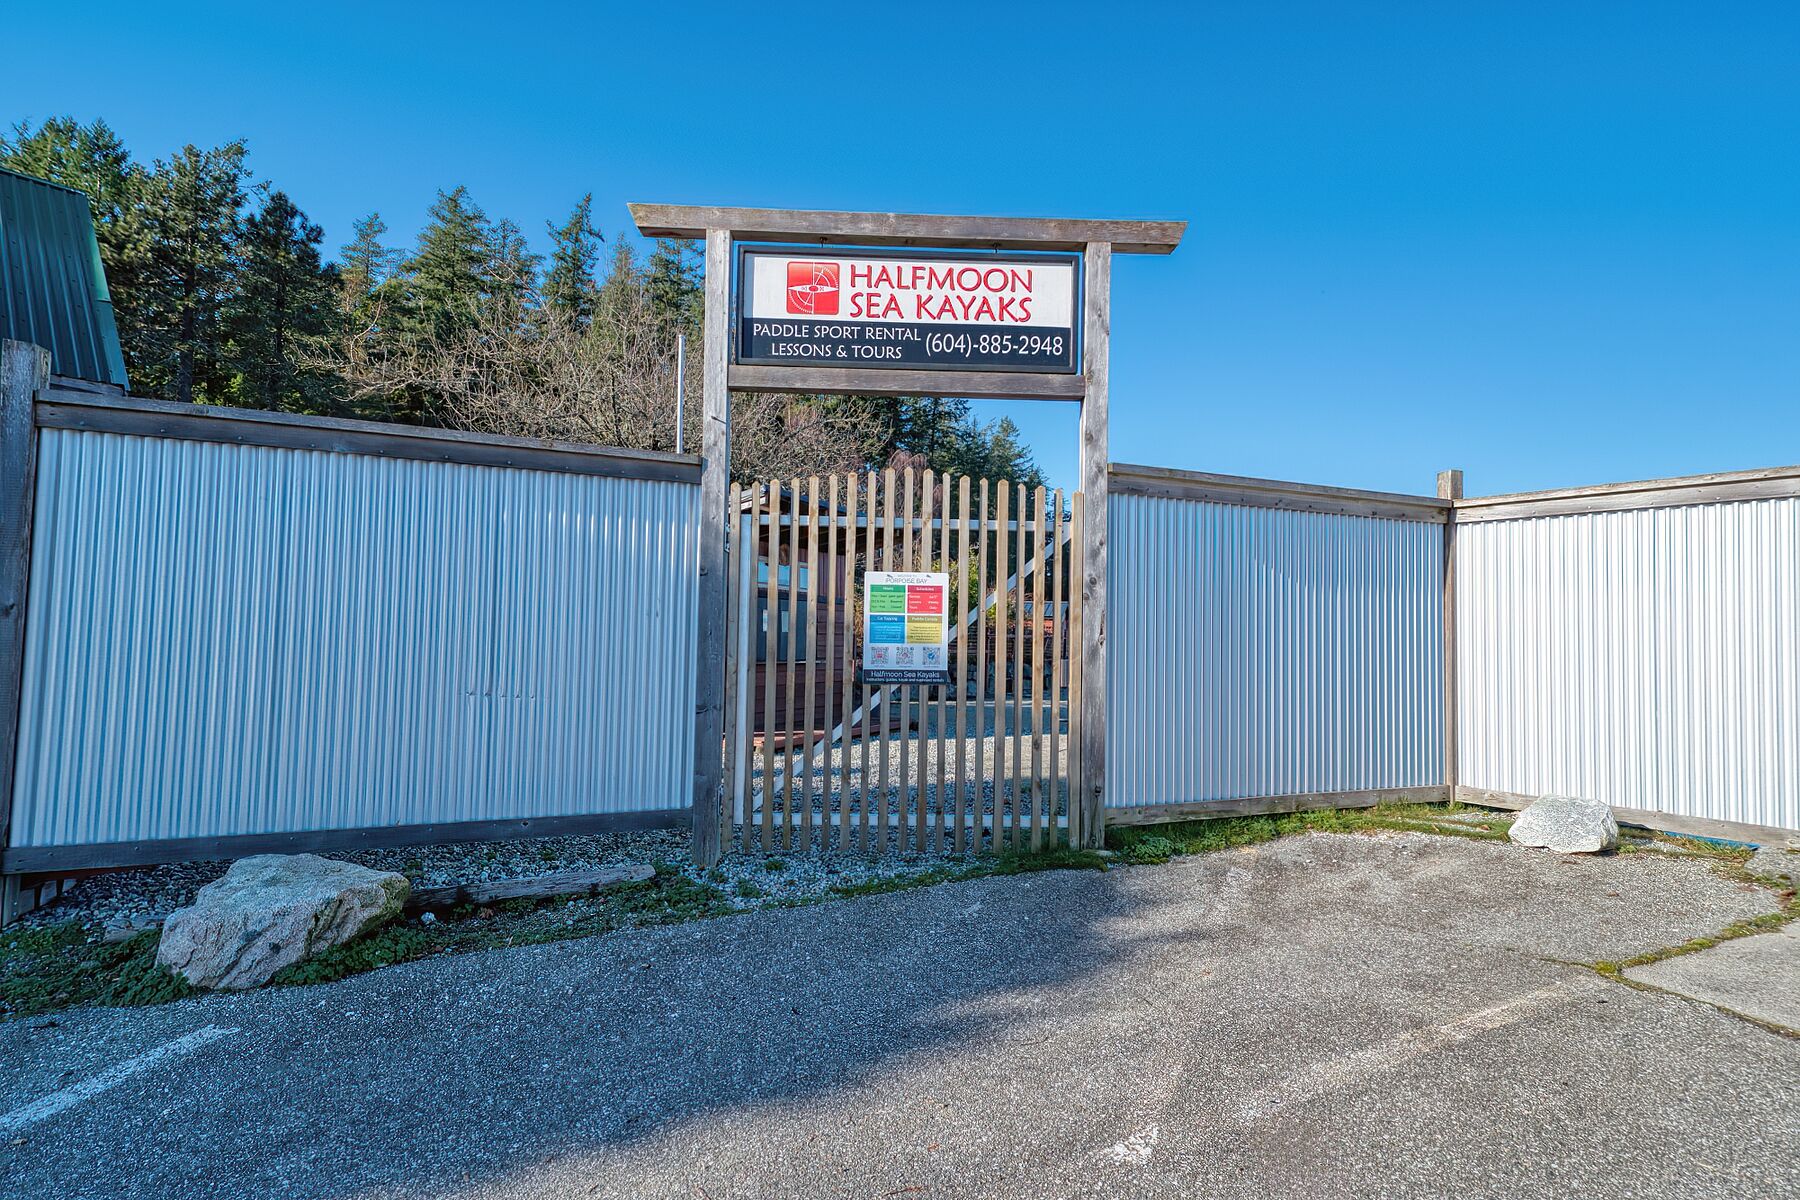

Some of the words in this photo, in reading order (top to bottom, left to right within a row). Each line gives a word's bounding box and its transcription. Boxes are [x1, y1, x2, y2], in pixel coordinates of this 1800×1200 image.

[850, 264, 1032, 293] HALFMOON
[850, 292, 904, 319] SEA
[916, 294, 1032, 322] KAYAKS
[753, 323, 809, 338] PADDLE
[814, 325, 861, 339] SPORT
[865, 327, 922, 341] RENTAL
[771, 343, 831, 357] LESSONS
[836, 345, 847, 358] &
[851, 345, 902, 359] TOURS
[925, 332, 1063, 358] (604)-885-2948
[871, 670, 903, 678] Halfmoon
[917, 671, 940, 679] Kayaks
